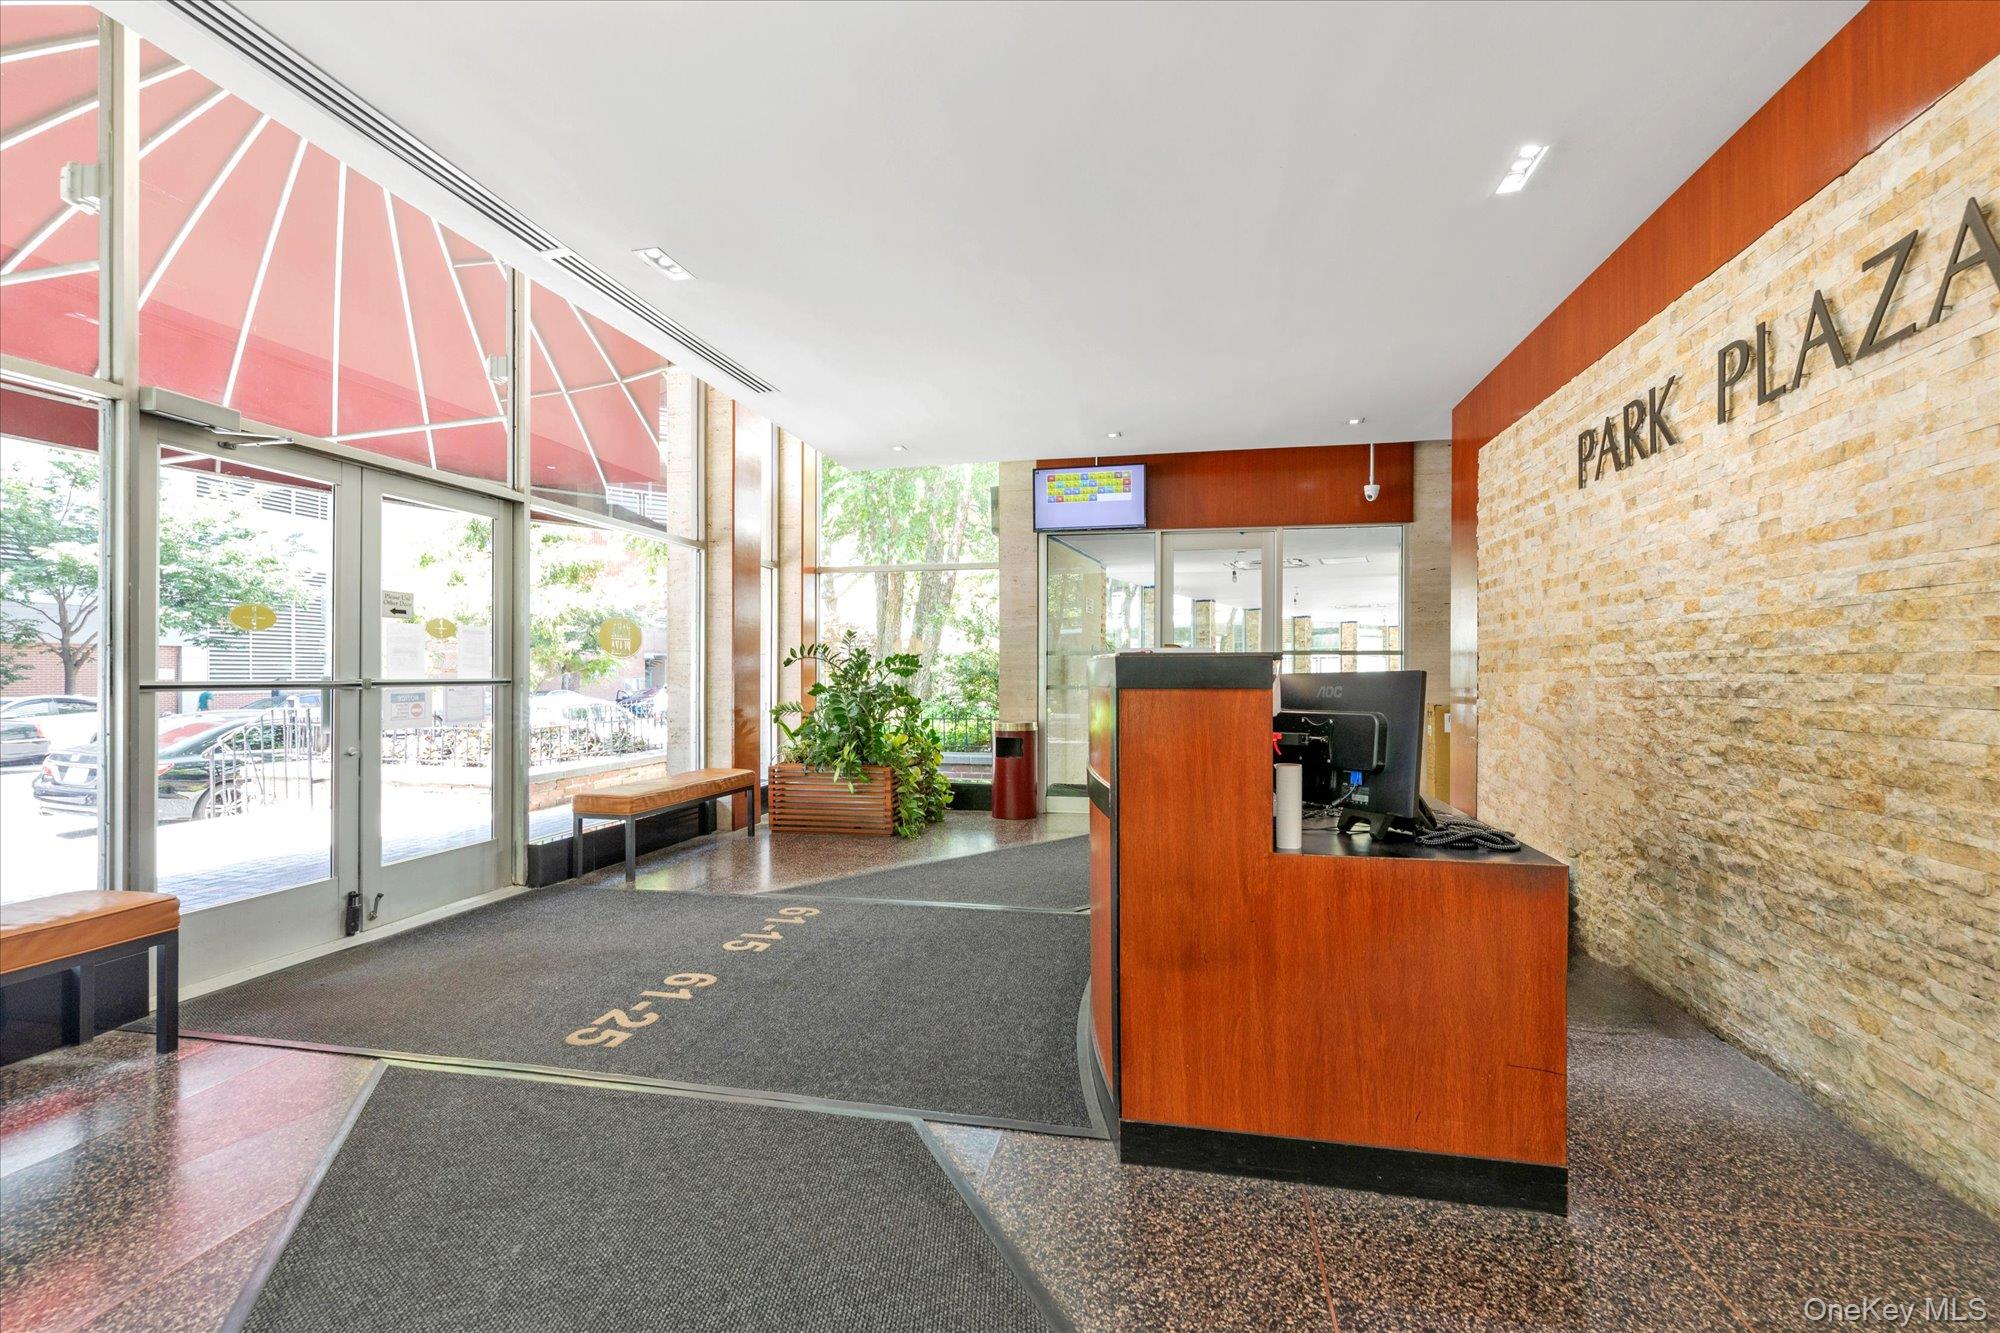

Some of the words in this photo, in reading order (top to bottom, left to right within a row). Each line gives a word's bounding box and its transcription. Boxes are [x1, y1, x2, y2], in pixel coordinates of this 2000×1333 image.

[1578, 375, 1676, 490] PARK
[1717, 196, 2000, 425] PLAZA
[1316, 685, 1343, 698] AOC
[722, 906, 820, 952] 61-15
[565, 972, 718, 1048] 61-25
